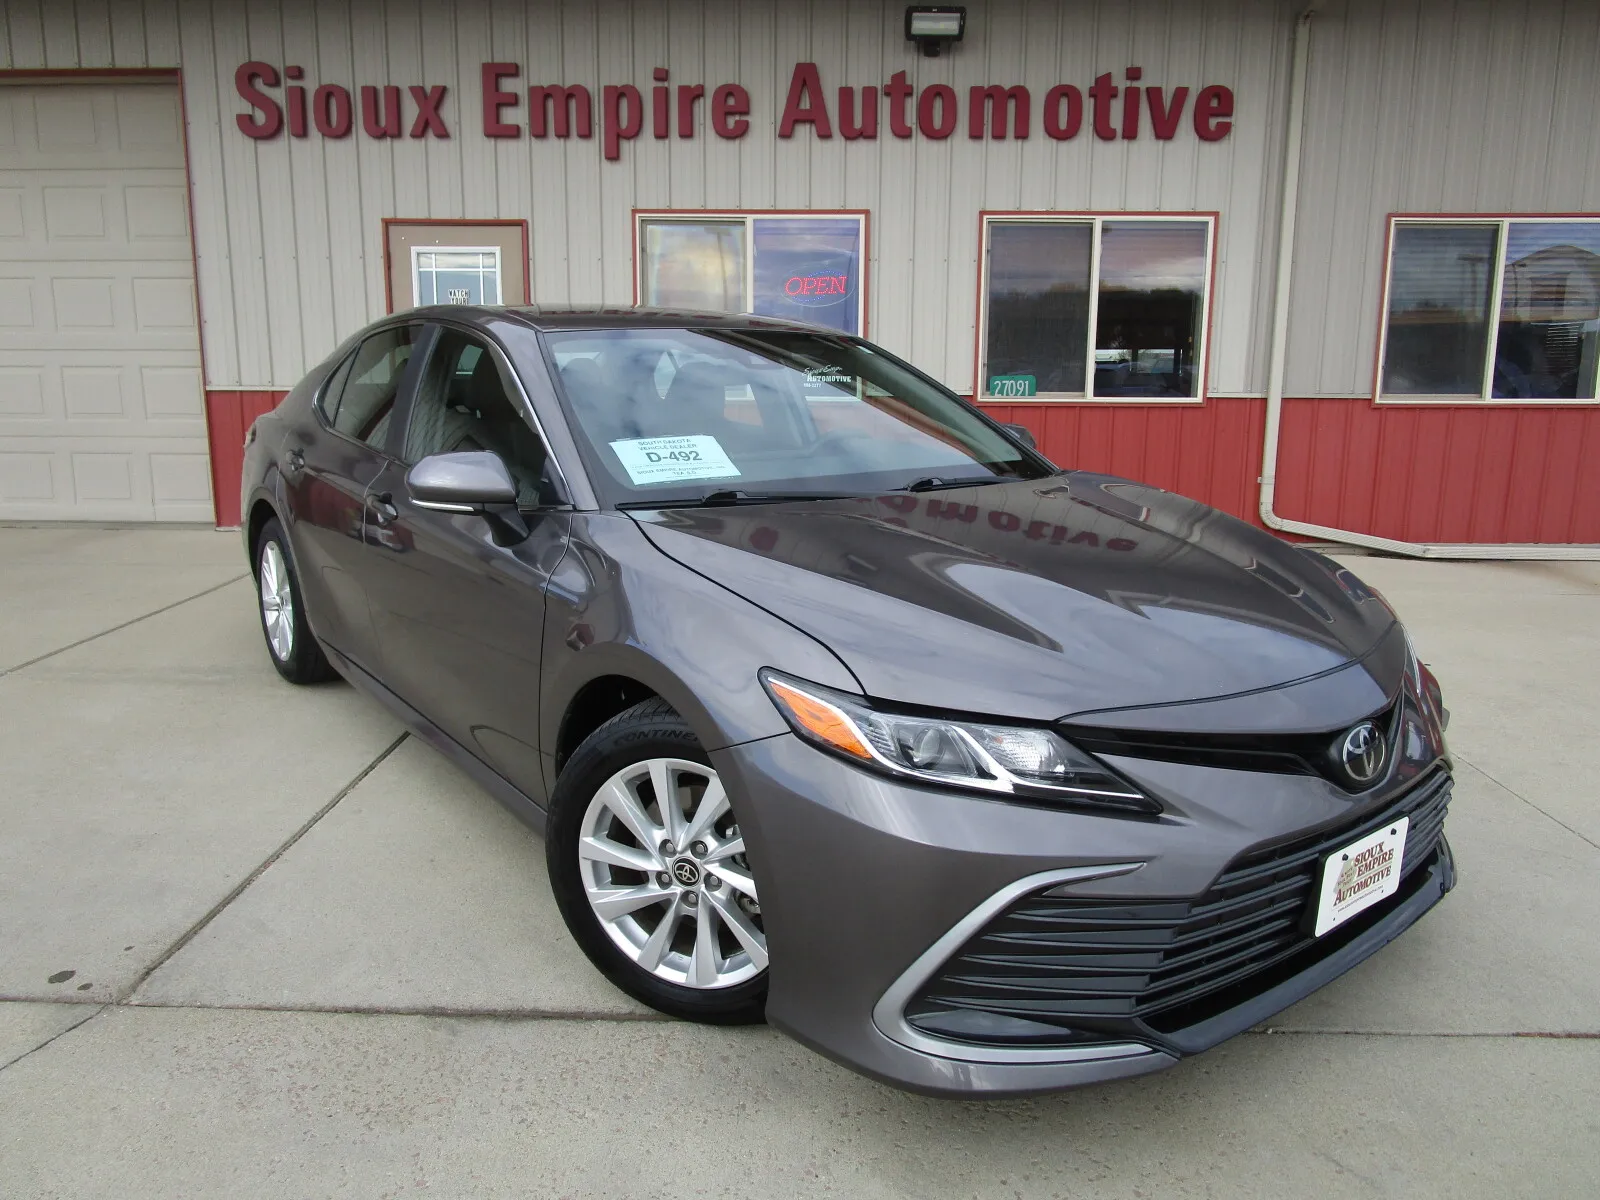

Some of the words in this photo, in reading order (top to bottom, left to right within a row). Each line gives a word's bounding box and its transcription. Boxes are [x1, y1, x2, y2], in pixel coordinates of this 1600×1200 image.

[235, 61, 450, 139] Sioux
[482, 62, 750, 160] Empire
[778, 62, 1235, 141] Automotive
[449, 289, 469, 298] WATCH
[785, 276, 848, 295] OPEN
[806, 373, 851, 382] AUTOMOTIVE
[994, 380, 1029, 396] 27091
[645, 450, 703, 462] D-492
[1354, 841, 1385, 867] SIOUX
[1356, 848, 1394, 878] EMPIRE
[1333, 865, 1391, 907] AUTOMOTIVE
